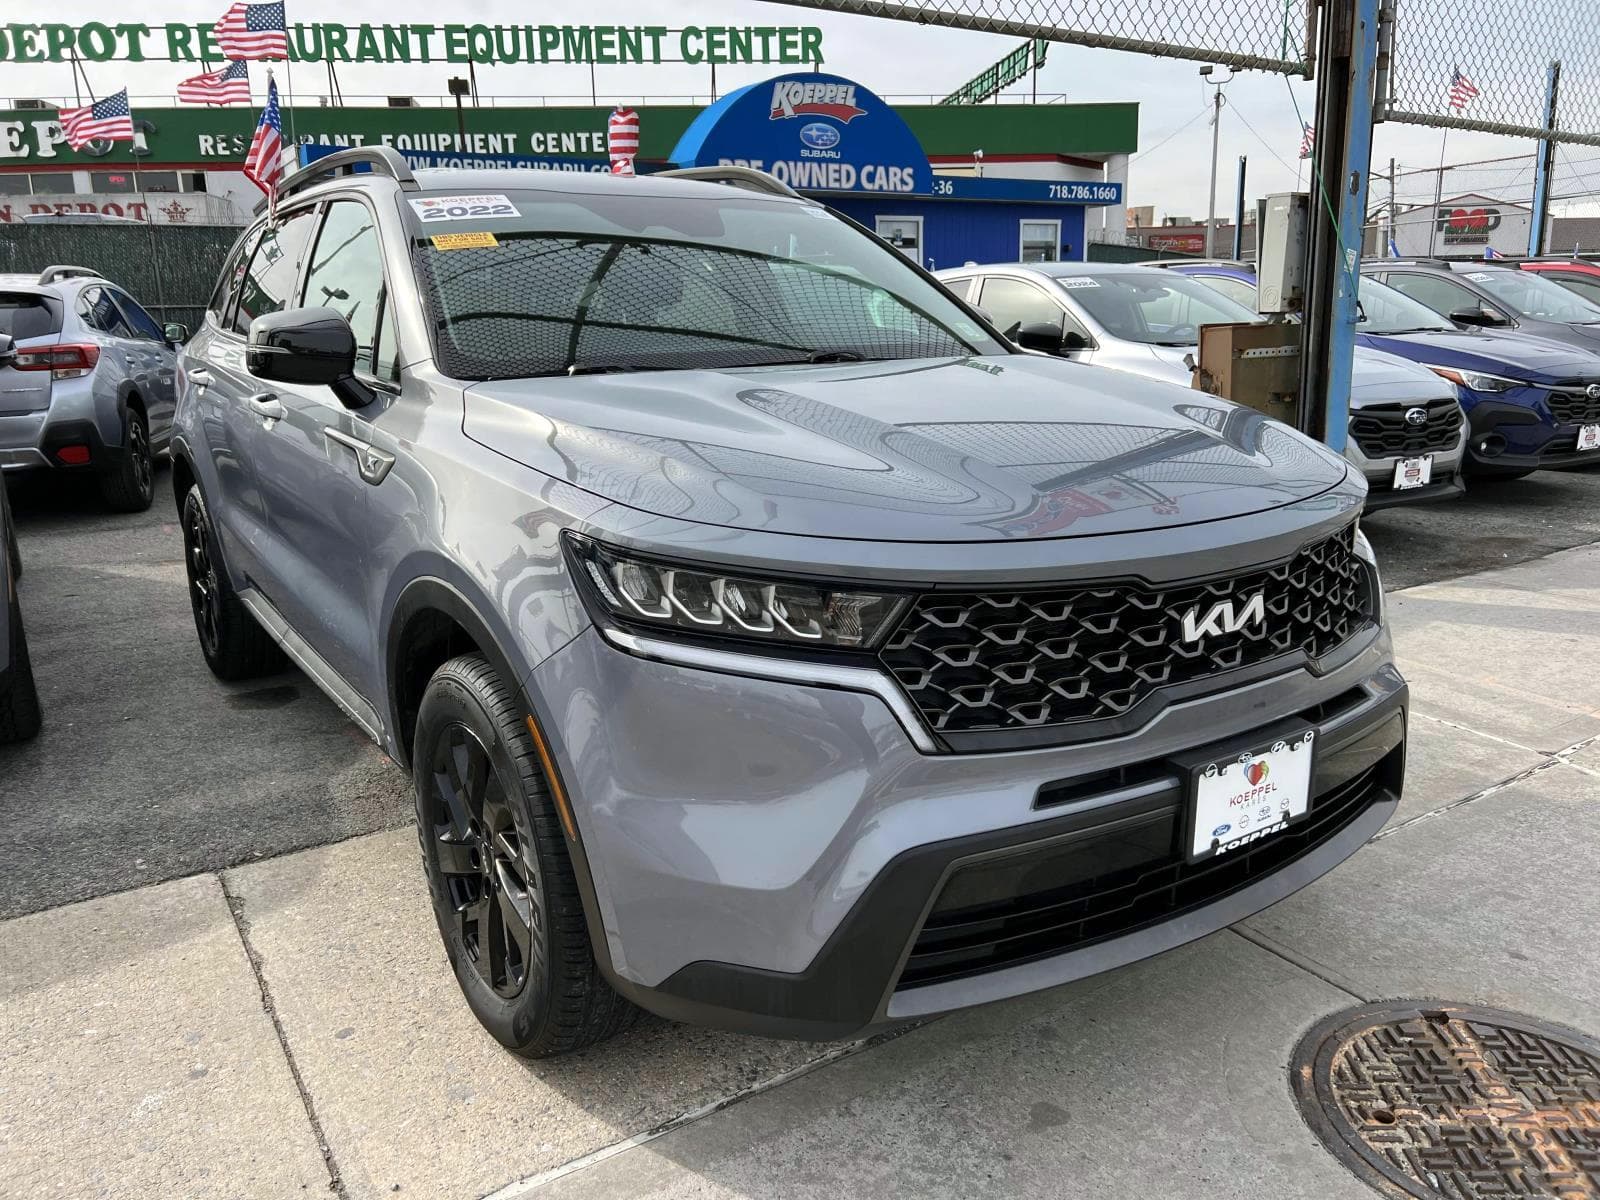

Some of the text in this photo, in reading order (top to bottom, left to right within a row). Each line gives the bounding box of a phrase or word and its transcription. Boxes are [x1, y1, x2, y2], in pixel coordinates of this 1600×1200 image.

[0, 21, 825, 67] EPOT REURANT EQUIPMENT CENTER
[771, 81, 857, 117] KOEPPEL
[531, 132, 611, 153] CENTE
[800, 149, 841, 159] SUBARU
[861, 166, 915, 192] CARS
[931, 180, 953, 195] -36
[1049, 184, 1117, 200] 718.786.1660
[422, 204, 514, 219] 2022
[1183, 594, 1265, 643] KIA
[1229, 782, 1278, 808] KOEPPEL
[1215, 821, 1289, 856] KOEPPEL
